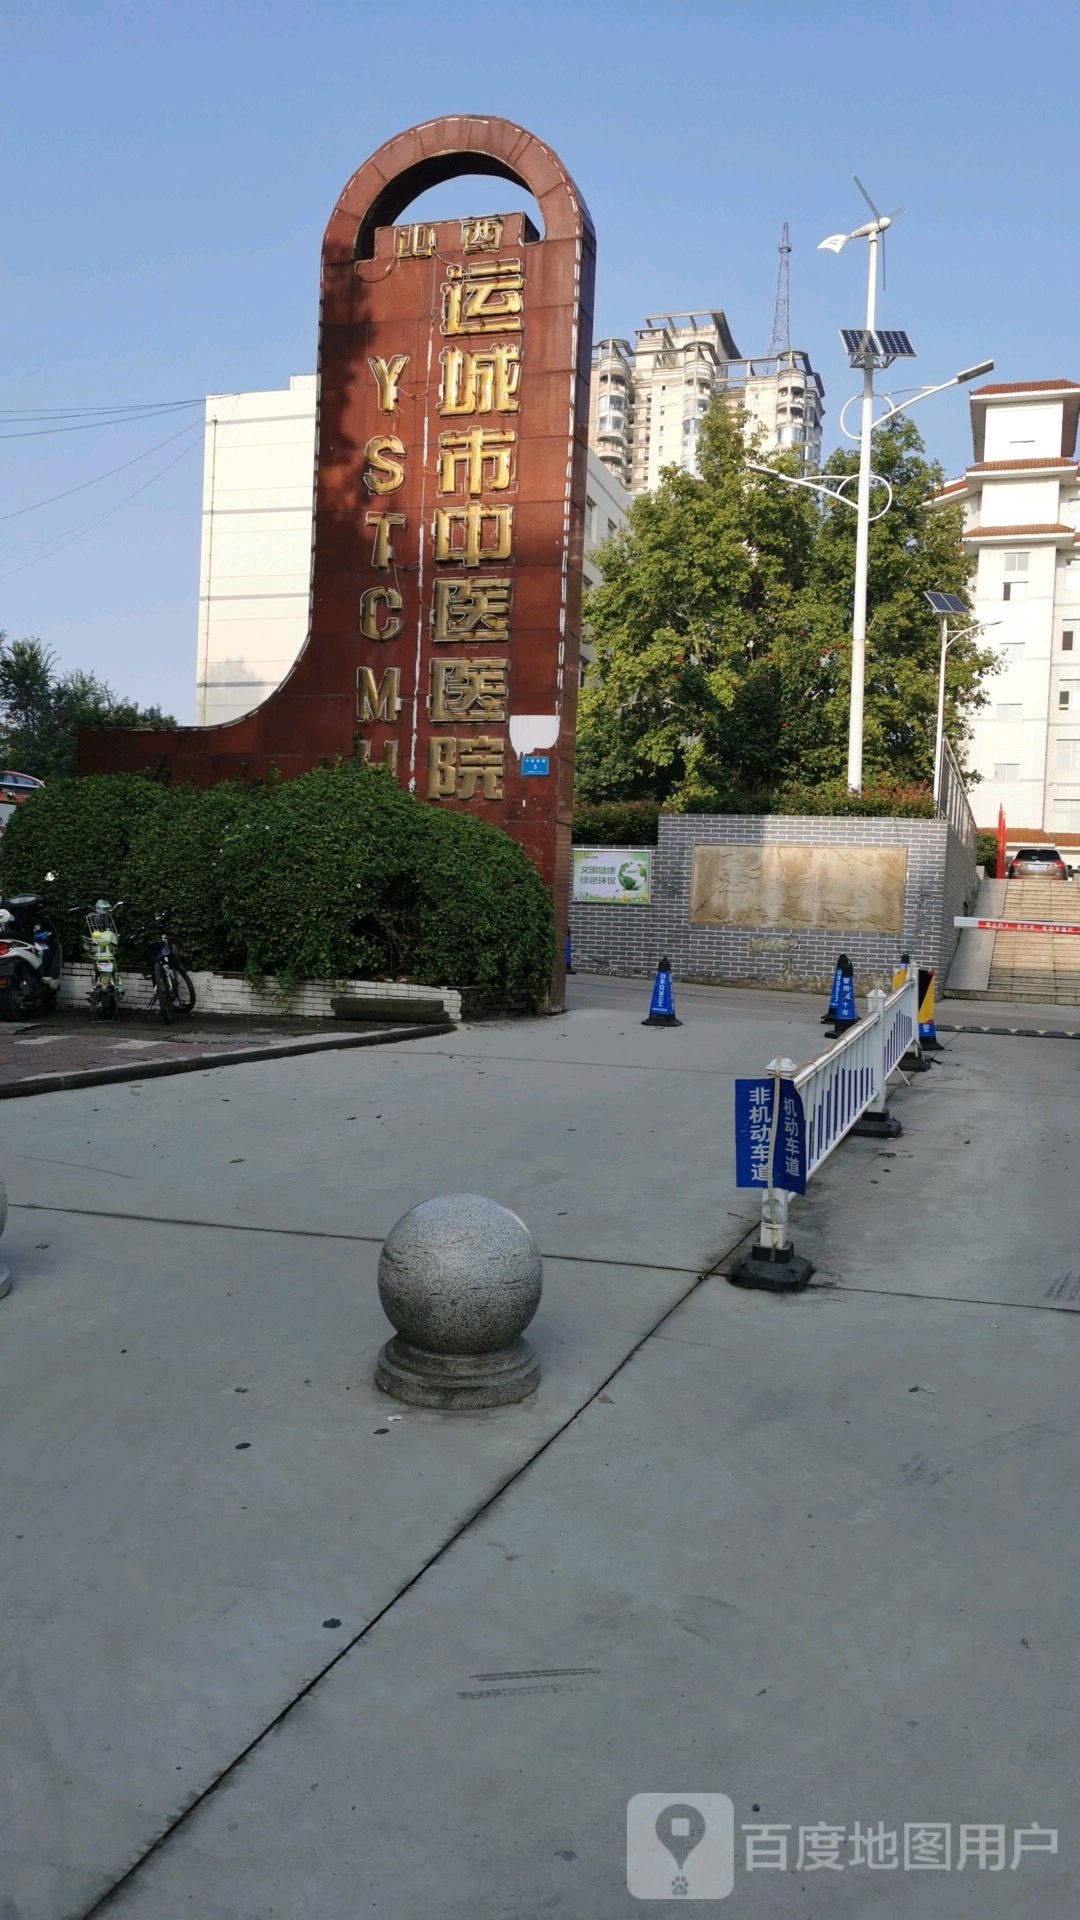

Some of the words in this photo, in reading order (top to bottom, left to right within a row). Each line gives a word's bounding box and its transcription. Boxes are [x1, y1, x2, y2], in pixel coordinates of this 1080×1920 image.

[394, 217, 503, 258] 山西
[429, 258, 523, 800] 运城市中医医院
[580, 876, 616, 885] 绿色环保
[581, 866, 616, 875] 文明健康
[749, 1086, 773, 1182] 非机动车道
[783, 1097, 800, 1177] 机动车道
